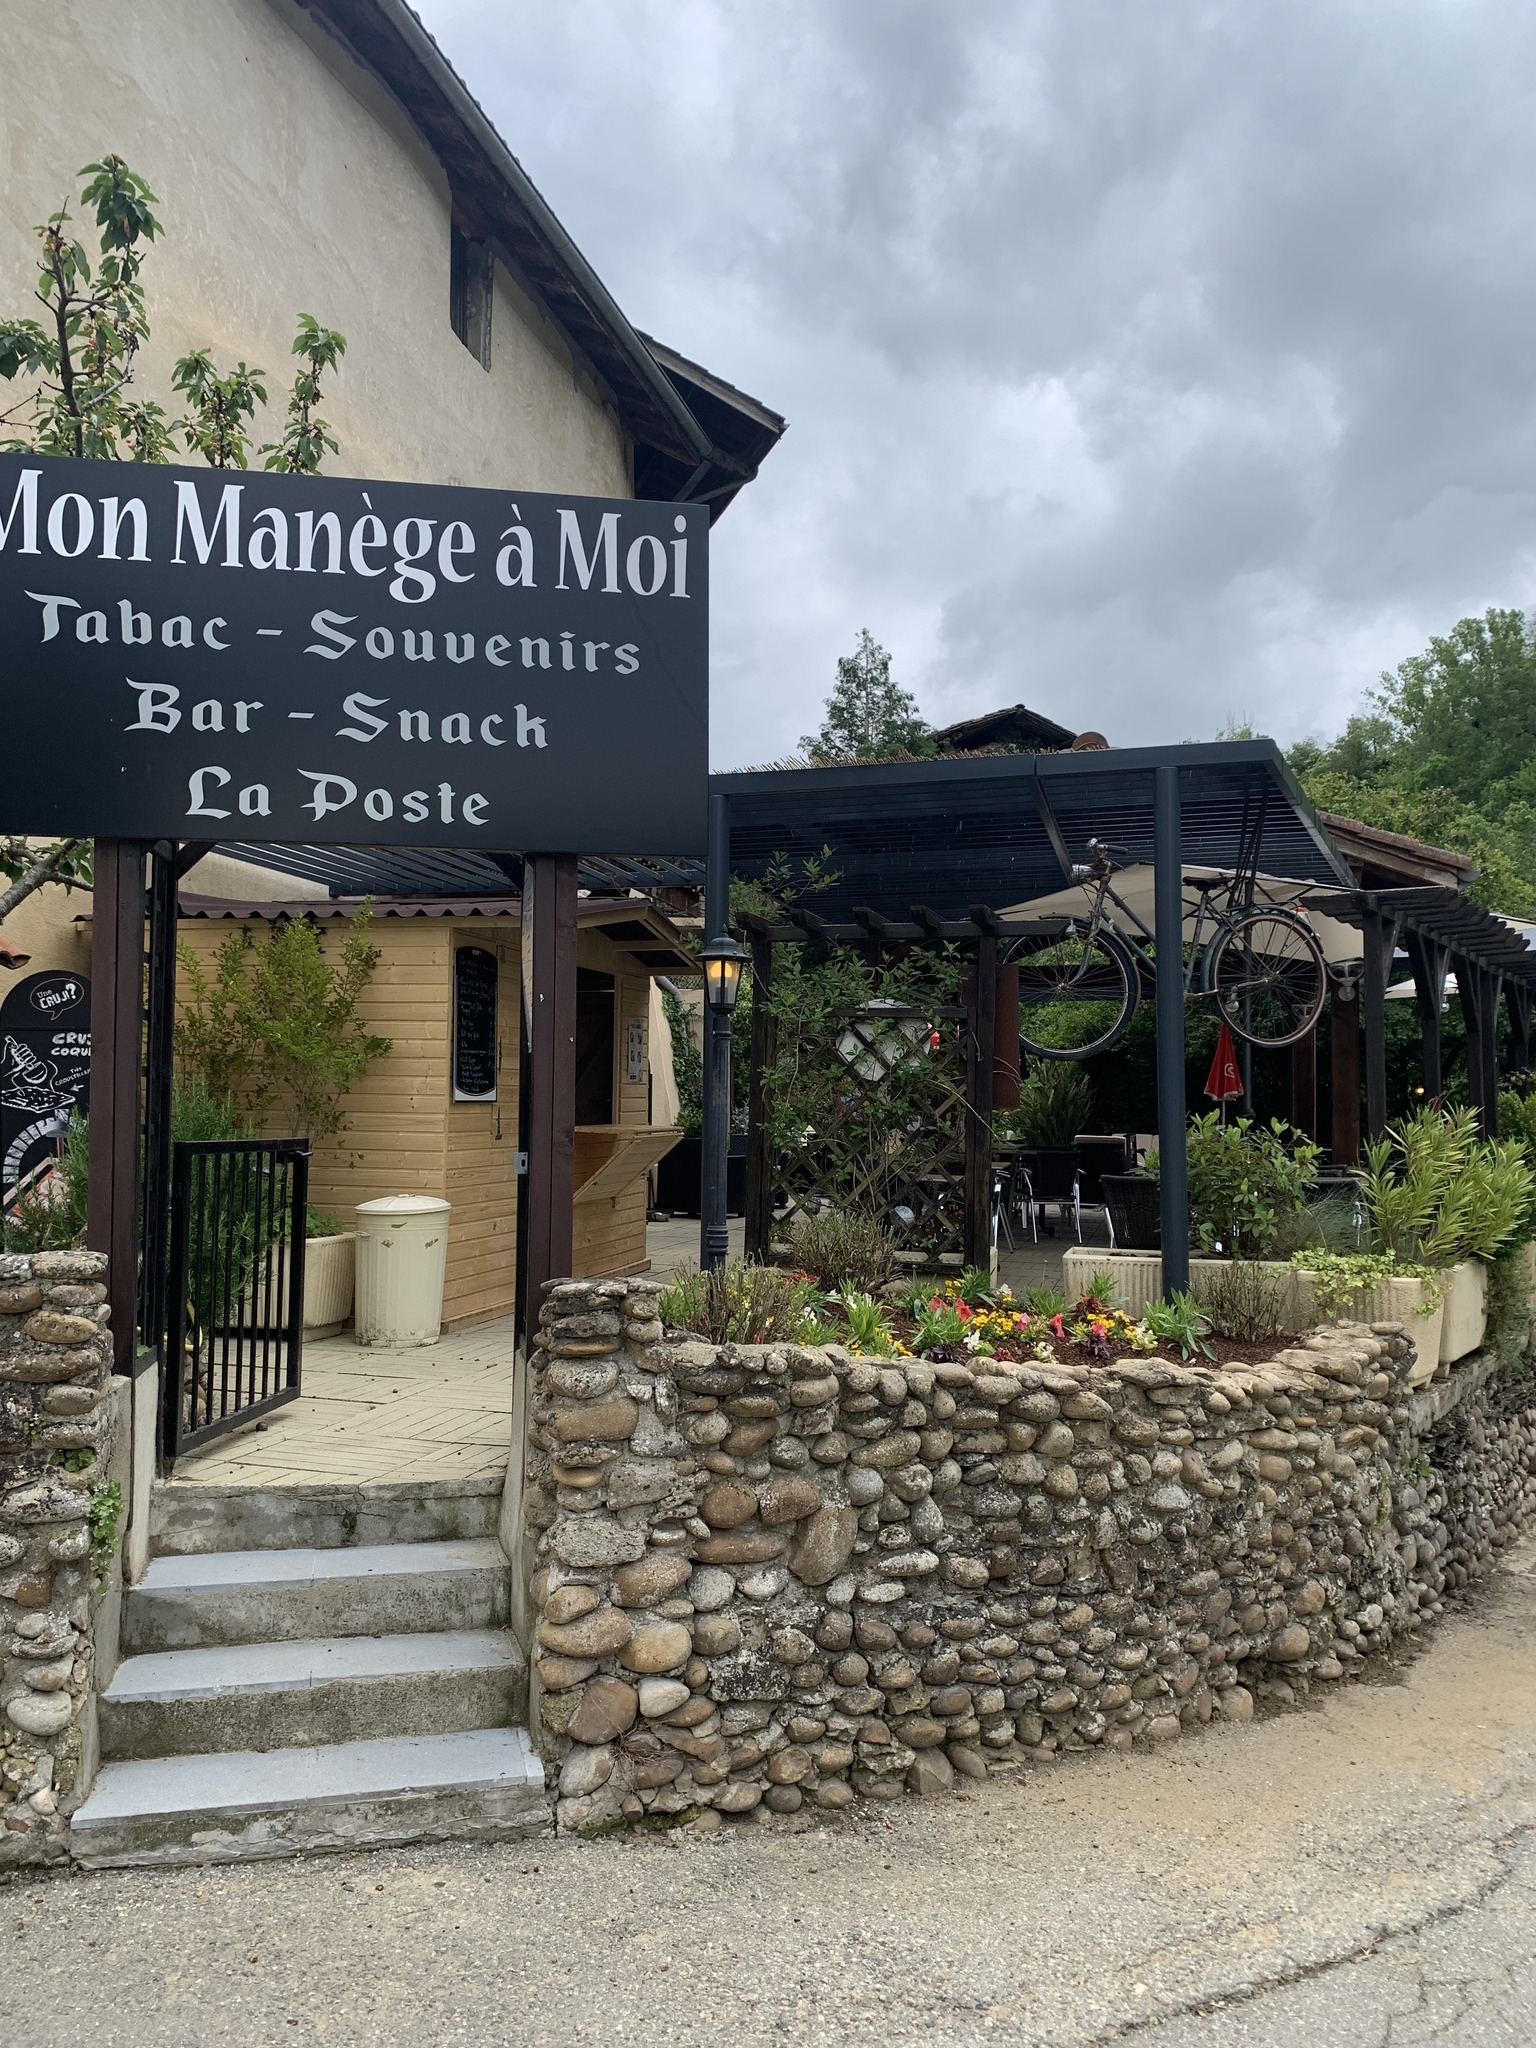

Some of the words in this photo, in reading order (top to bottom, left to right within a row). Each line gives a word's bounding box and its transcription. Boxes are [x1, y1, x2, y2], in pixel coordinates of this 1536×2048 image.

[0, 468, 152, 562] Mon
[170, 480, 476, 604] Manège
[495, 503, 538, 588] à
[554, 508, 691, 599] Moi
[24, 589, 232, 651] Tabac
[302, 608, 640, 675] Souvenirs
[123, 676, 265, 734] Bar
[334, 691, 549, 749] Snack
[184, 765, 273, 820] La
[297, 768, 490, 826] Poste
